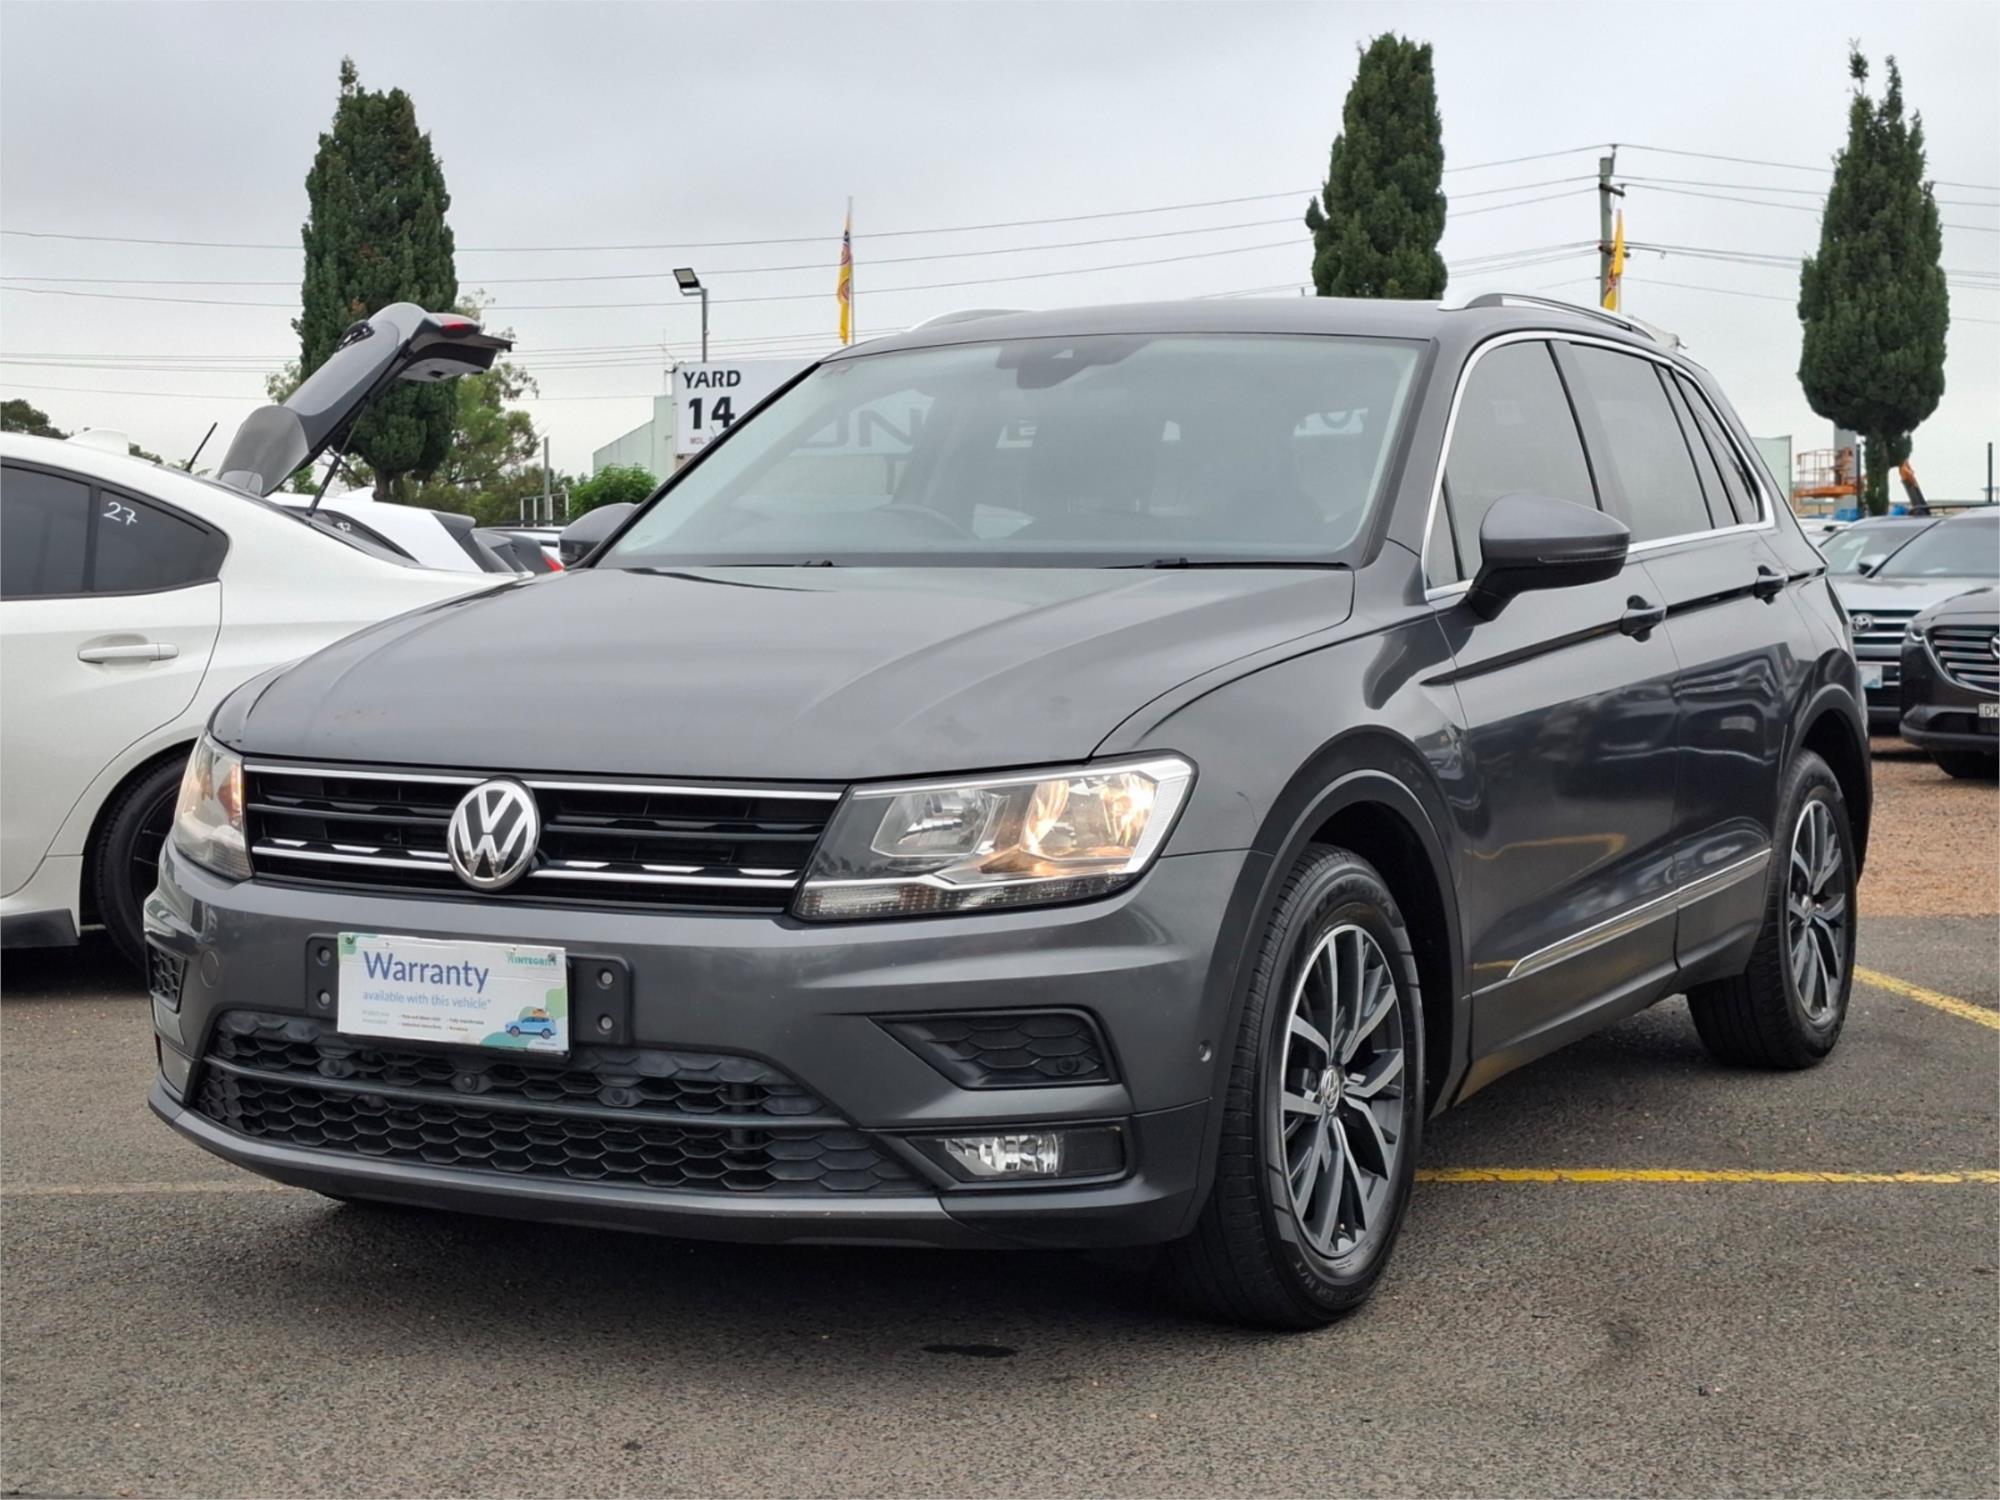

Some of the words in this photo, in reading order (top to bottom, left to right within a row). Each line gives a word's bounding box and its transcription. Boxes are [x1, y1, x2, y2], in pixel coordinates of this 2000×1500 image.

[683, 370, 741, 389] YARD
[689, 396, 735, 429] 14
[103, 502, 138, 525] 27
[363, 951, 489, 994] Warranty
[362, 990, 405, 1003] available
[407, 993, 429, 1005] with
[431, 994, 450, 1006] this
